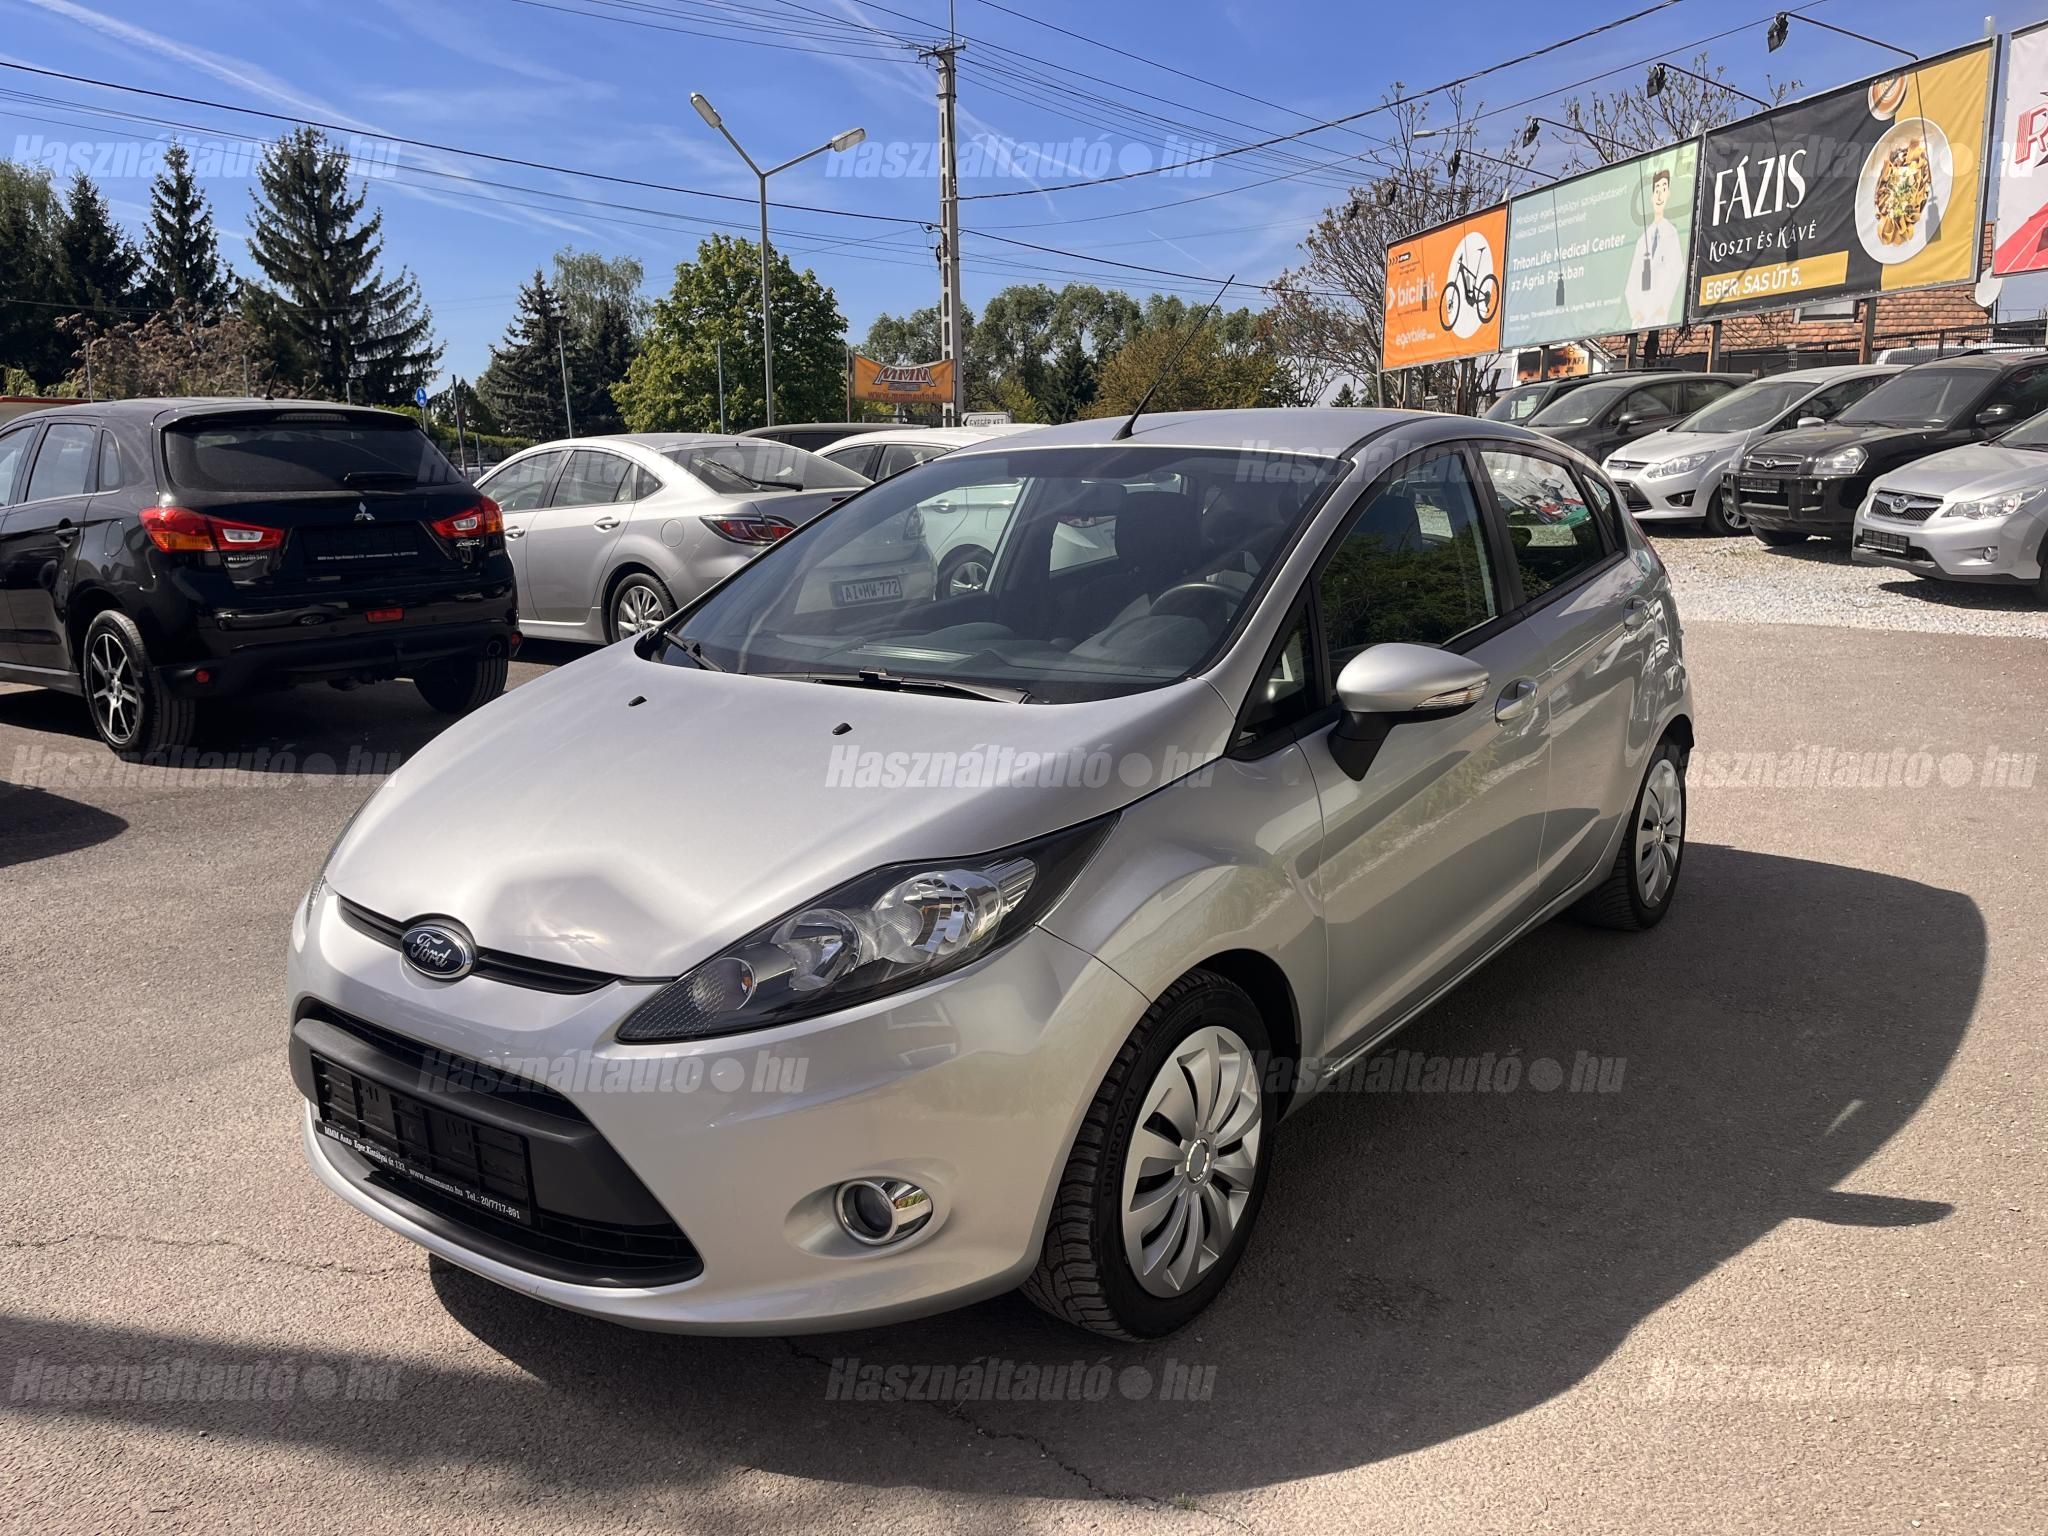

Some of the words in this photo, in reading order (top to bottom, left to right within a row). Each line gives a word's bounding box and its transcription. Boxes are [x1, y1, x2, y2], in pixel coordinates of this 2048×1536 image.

[1712, 149, 1807, 227] FÁZIS
[1513, 250, 1552, 271] TritonLife
[1554, 240, 1590, 261] Medical
[1592, 234, 1626, 253] Center
[1511, 280, 1520, 291] az
[1522, 273, 1545, 291] Agria
[1547, 265, 1585, 283] Pakban
[1706, 277, 1740, 301] EGER,
[1743, 272, 1771, 294] SAS
[1771, 264, 1791, 290] ÚT
[410, 933, 452, 968] Ford
[1103, 1086, 1140, 1198] UNIROYAL
